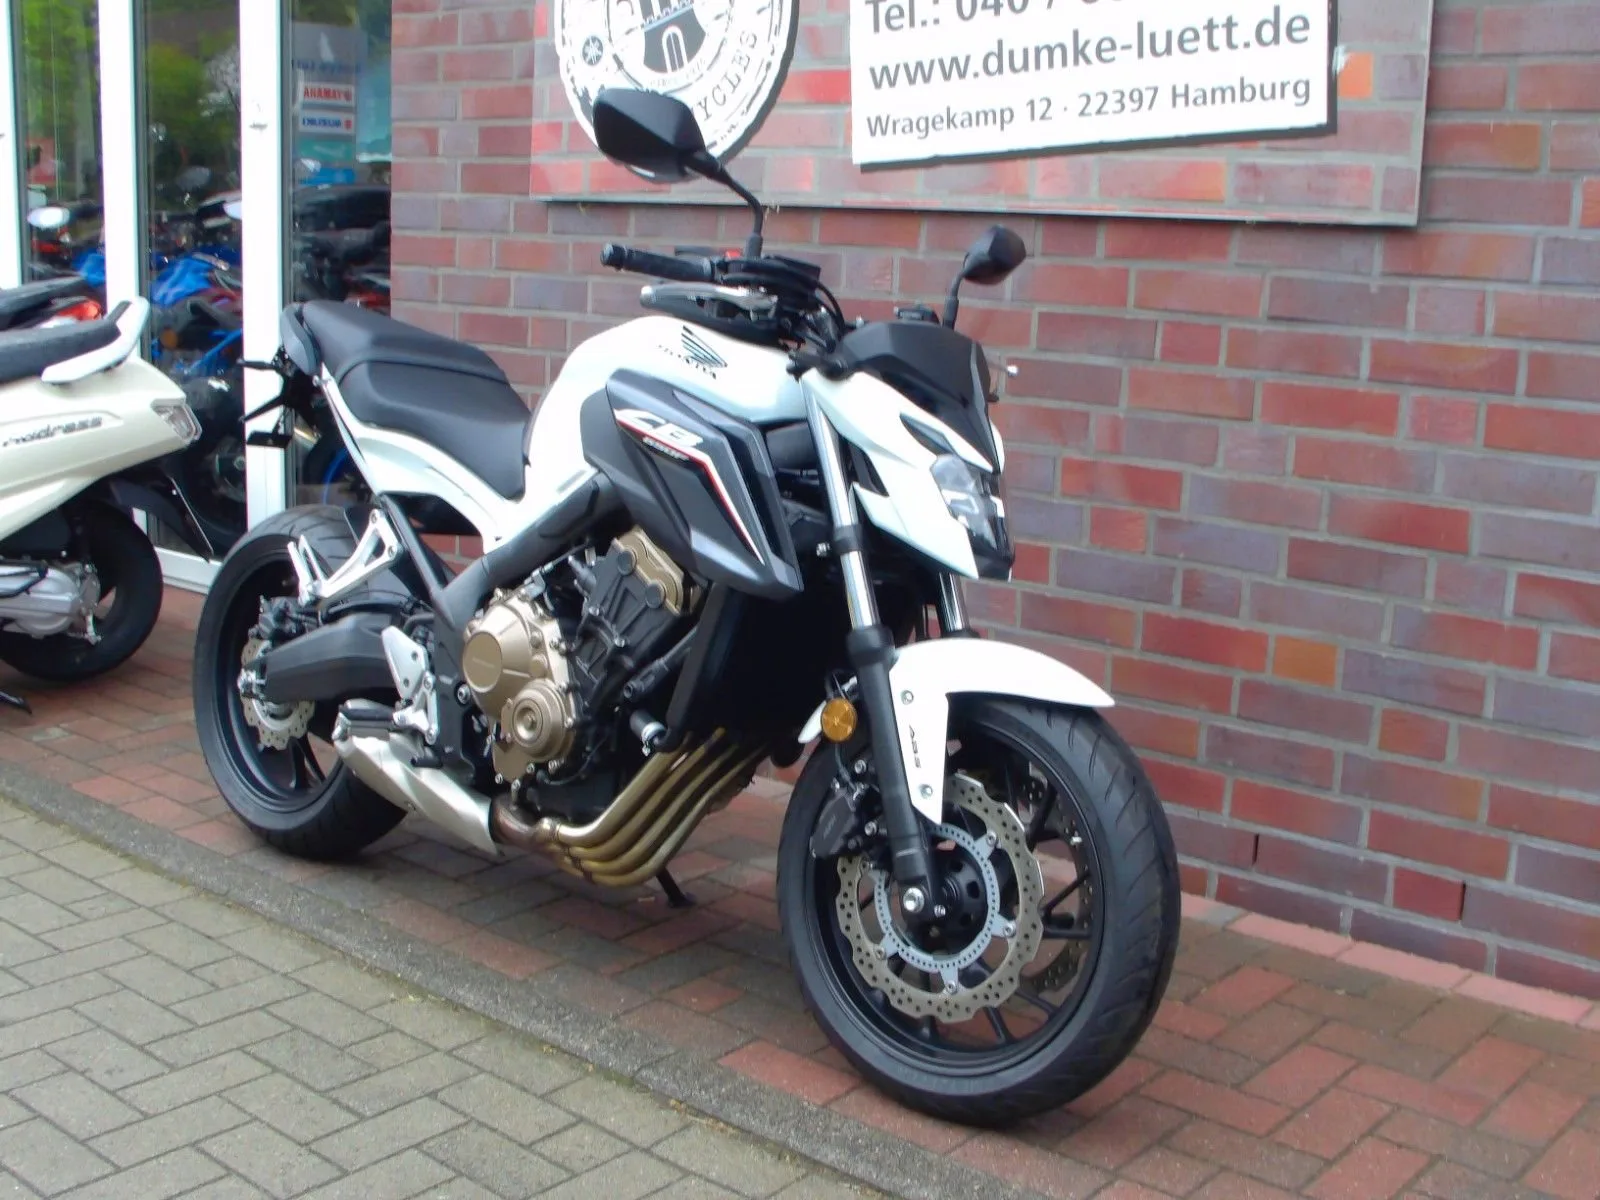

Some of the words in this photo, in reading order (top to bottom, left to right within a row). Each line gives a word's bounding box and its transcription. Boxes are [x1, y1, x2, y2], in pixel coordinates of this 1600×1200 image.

[865, 0, 940, 33] Tel.:
[869, 5, 1310, 90] www.dumke-luett.de
[693, 31, 757, 121] YCLES
[867, 105, 1015, 140] Wragekamp
[1026, 96, 1053, 122] 12
[1078, 86, 1159, 117] 22397
[1171, 77, 1311, 108] Hamburg
